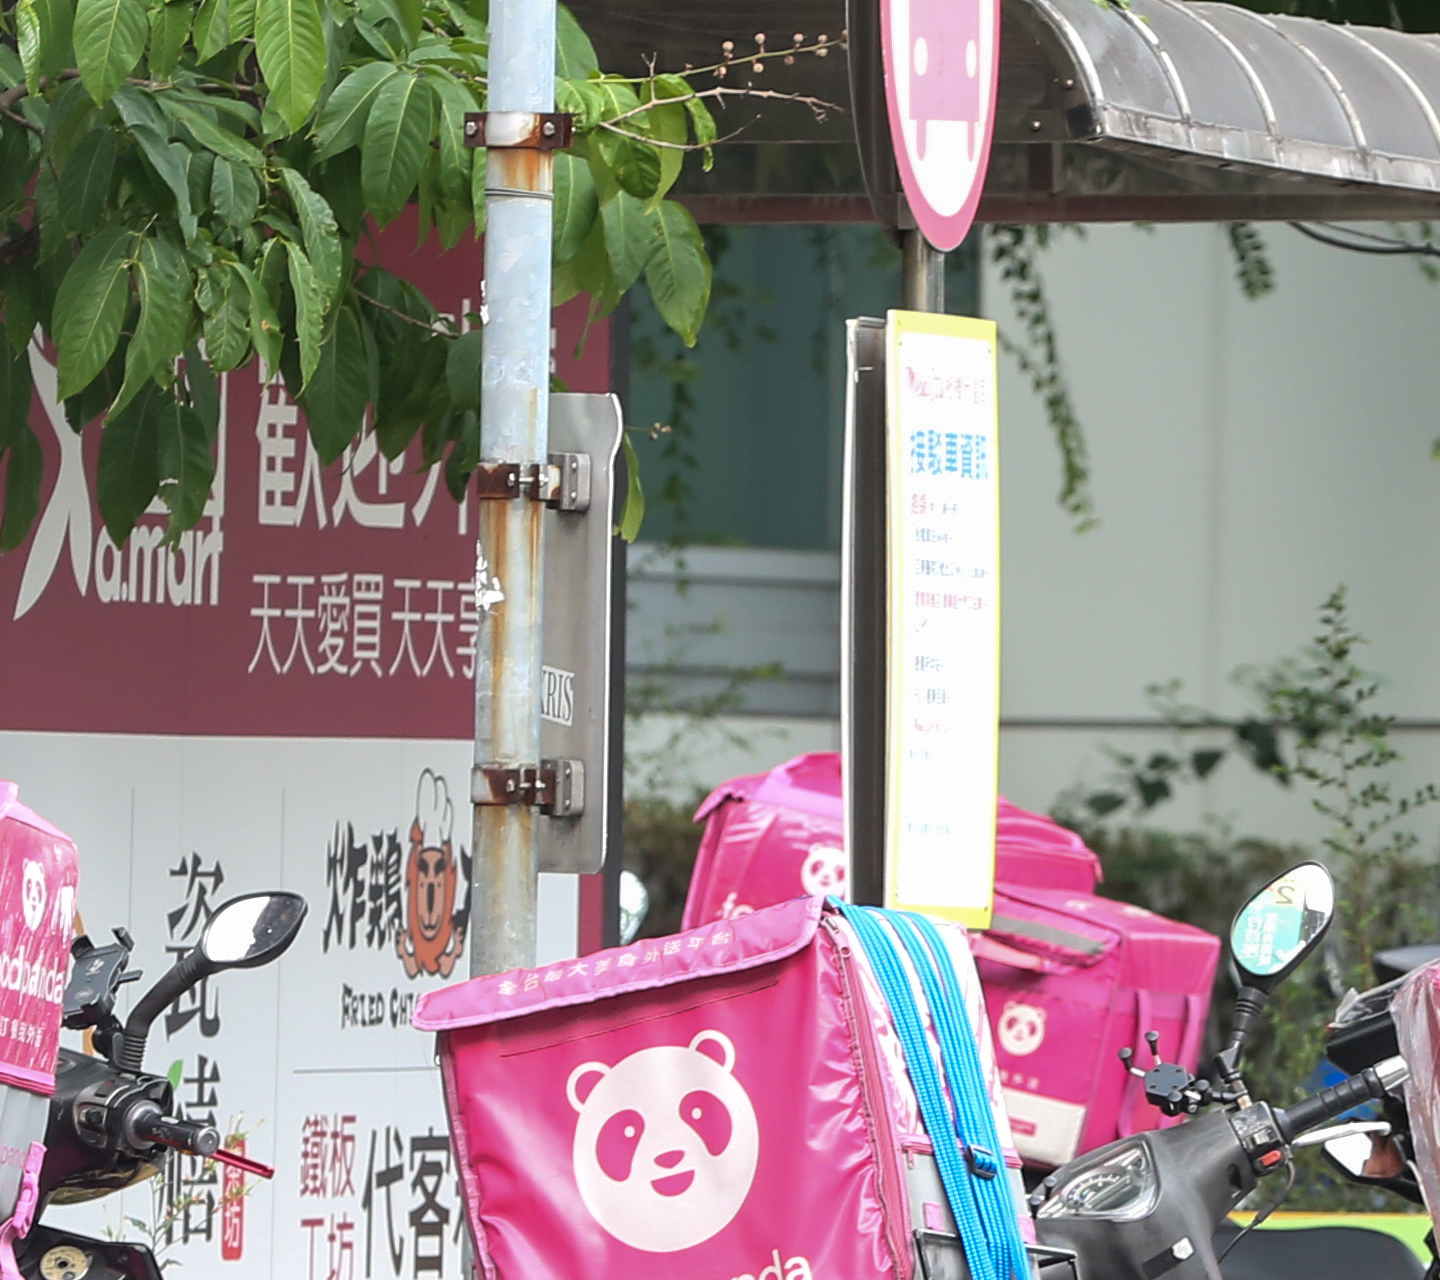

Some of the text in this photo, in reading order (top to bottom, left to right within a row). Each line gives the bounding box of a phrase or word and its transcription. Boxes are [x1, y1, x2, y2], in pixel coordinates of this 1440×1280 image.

[248, 572, 383, 678] 天天愛買
[299, 1114, 357, 1199] 鐵板
[361, 1125, 464, 1280] 代客
